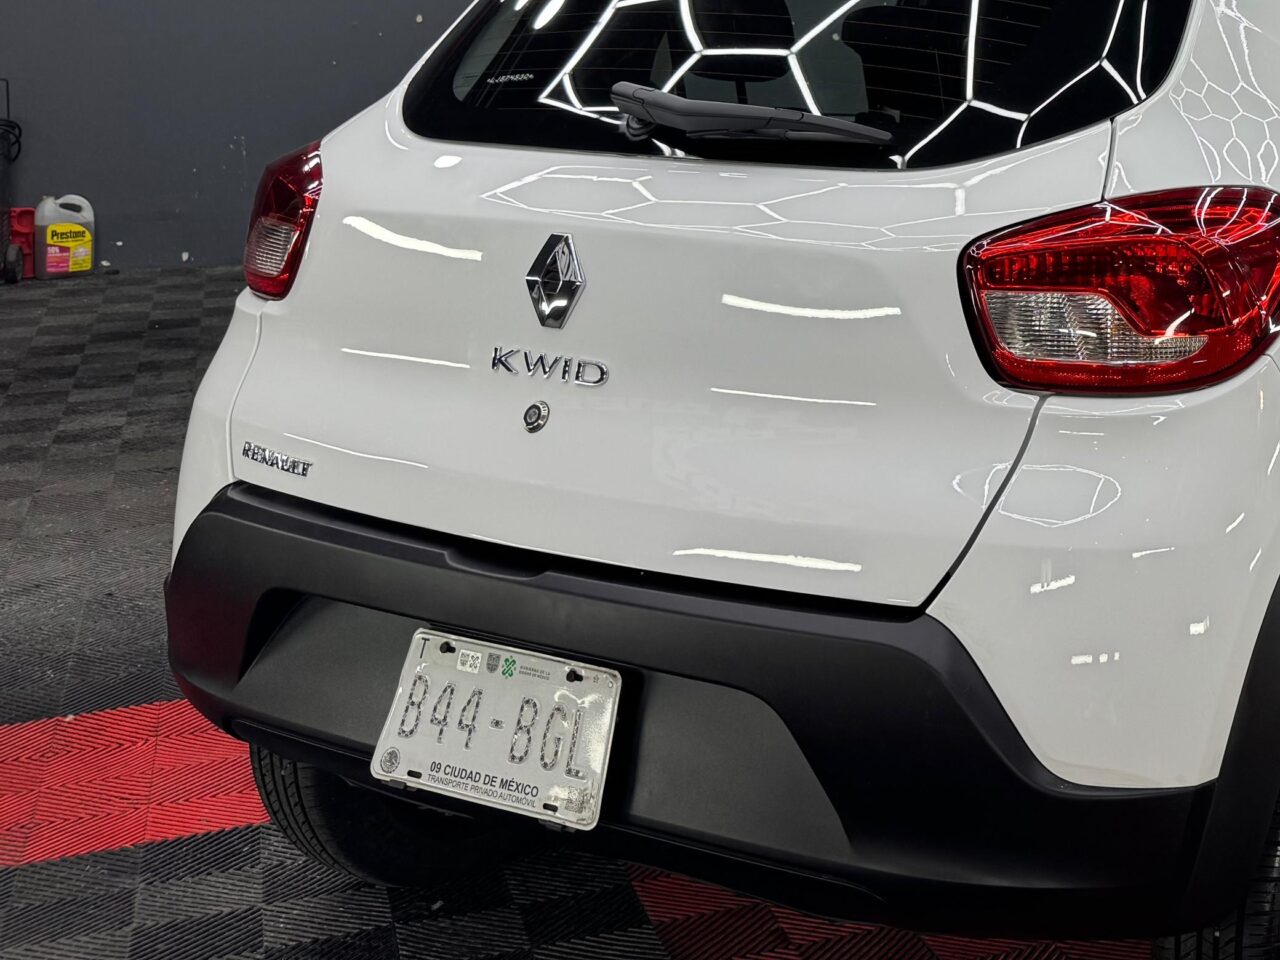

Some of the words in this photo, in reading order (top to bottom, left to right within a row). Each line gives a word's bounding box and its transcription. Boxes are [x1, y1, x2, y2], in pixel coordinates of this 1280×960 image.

[51, 229, 86, 240] Prestone
[490, 346, 610, 387] KWID
[242, 440, 313, 477] RENAULT
[397, 674, 589, 781] B44-BGL
[427, 773, 469, 791] TRANSPORTE
[470, 784, 498, 798] PRIVADO
[430, 761, 442, 774] 09
[443, 764, 481, 783] CIUDAD
[483, 774, 498, 788] DE
[499, 777, 539, 798] MÉXICO
